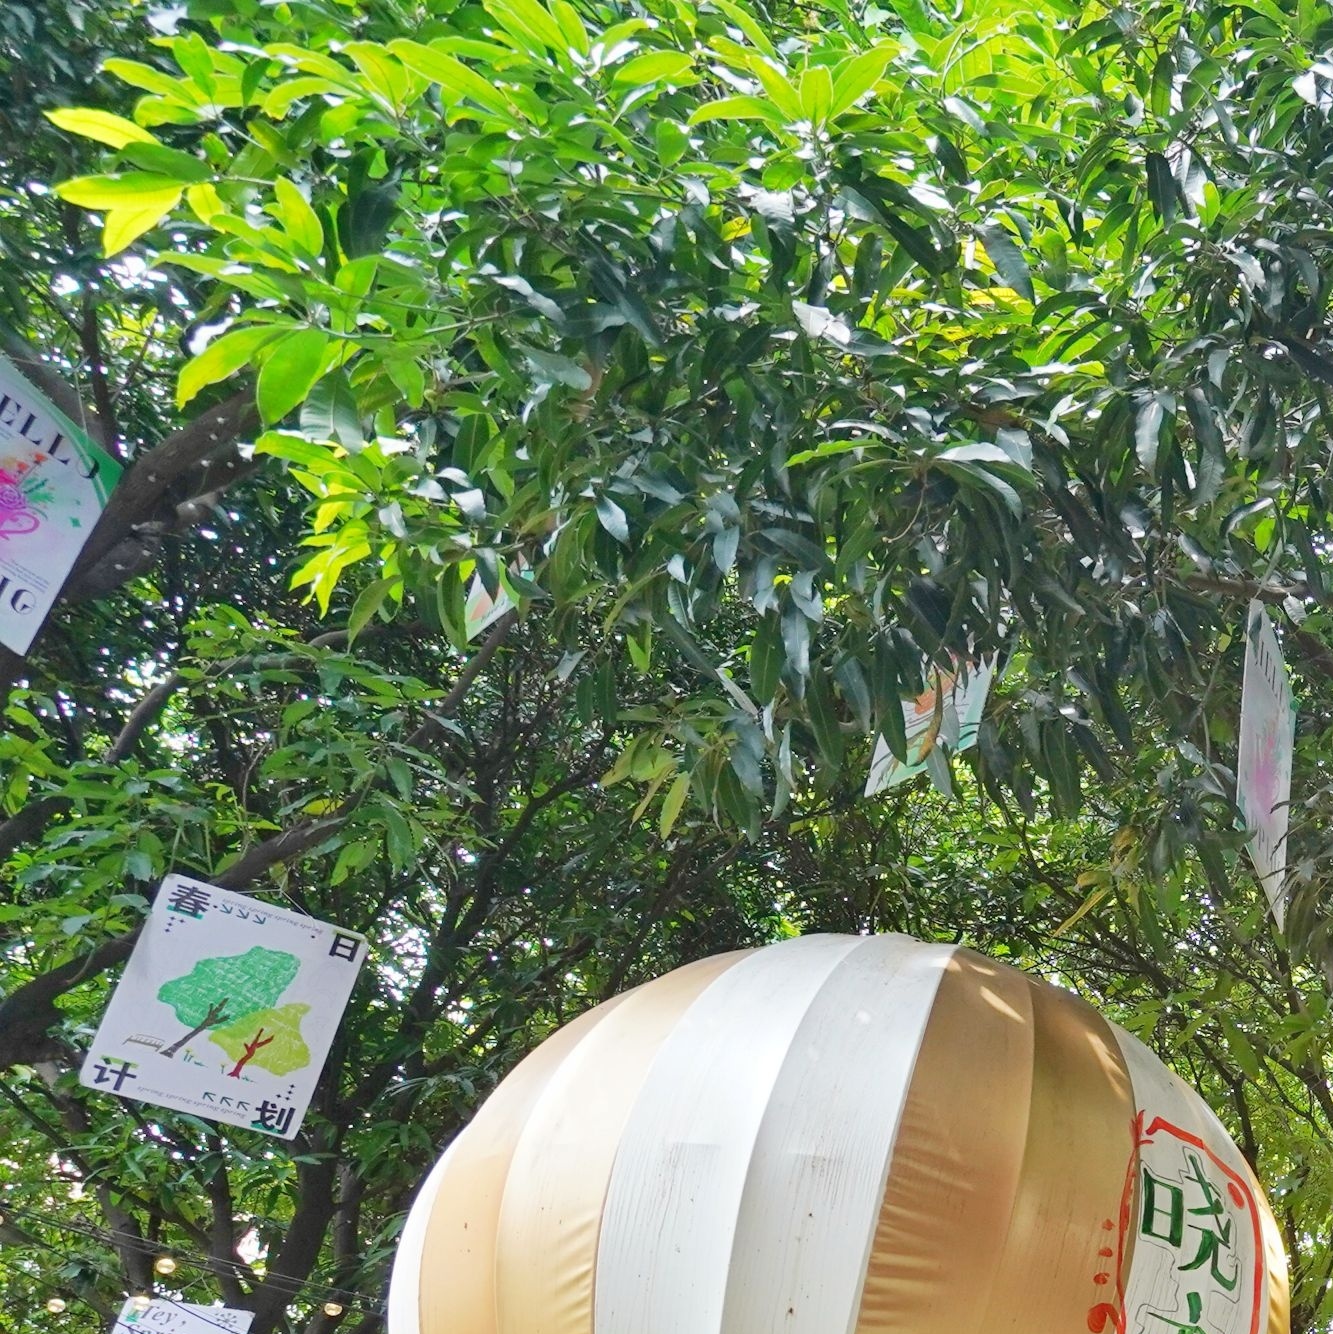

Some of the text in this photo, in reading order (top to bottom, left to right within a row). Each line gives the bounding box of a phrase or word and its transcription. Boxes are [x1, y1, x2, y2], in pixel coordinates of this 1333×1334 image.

[167, 883, 212, 918] 春
[329, 932, 361, 963] 日
[93, 1056, 137, 1092] 计
[253, 1100, 297, 1135] 划
